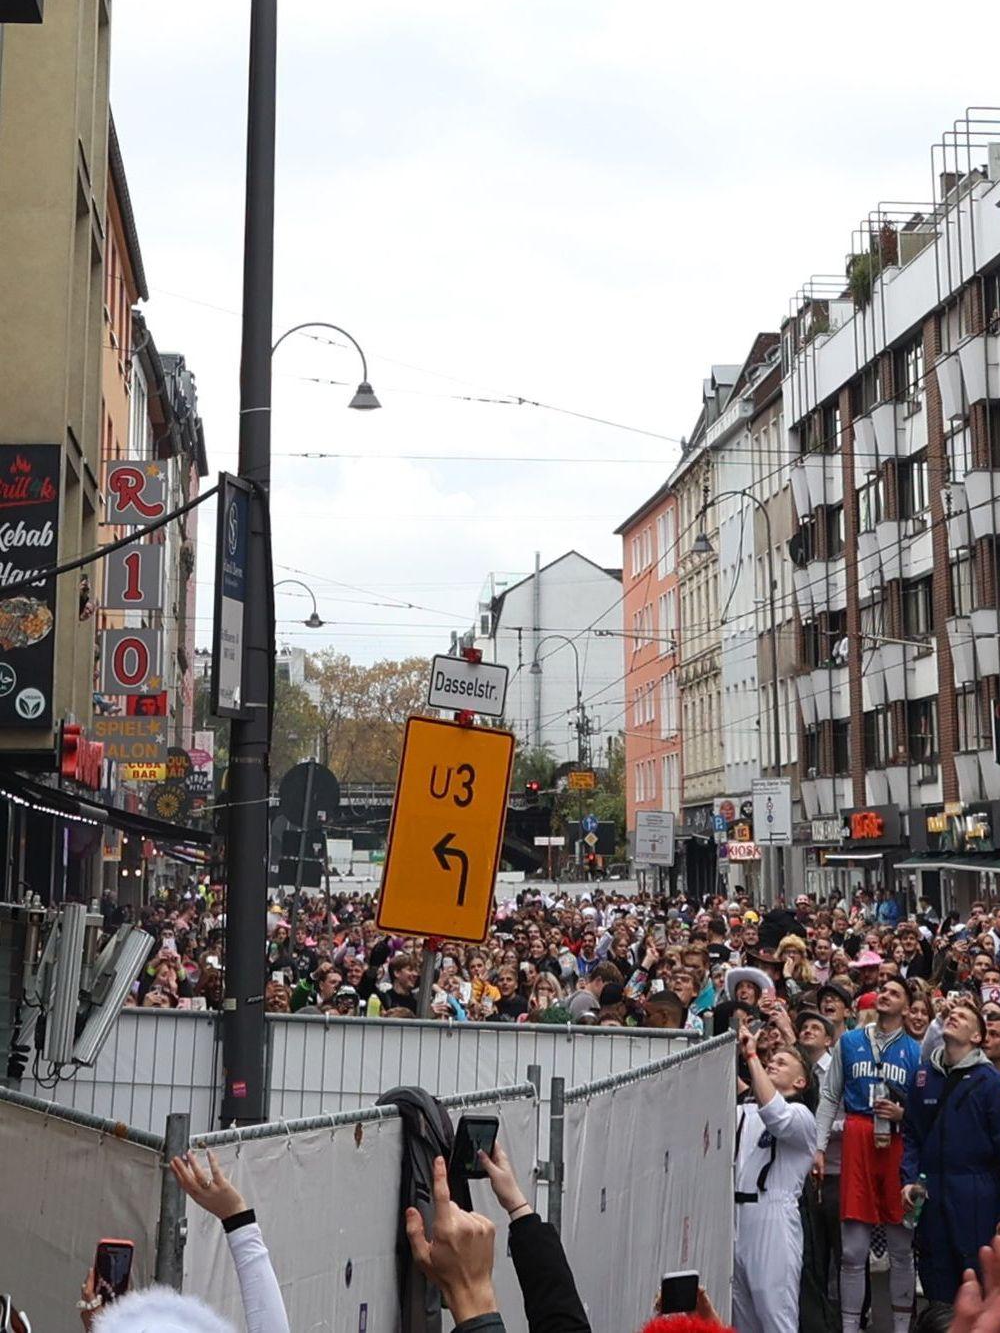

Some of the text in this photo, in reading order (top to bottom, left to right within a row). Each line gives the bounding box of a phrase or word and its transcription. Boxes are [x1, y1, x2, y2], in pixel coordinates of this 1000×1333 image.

[434, 671, 498, 701] Dasselstr.
[95, 721, 146, 737] SPIEL
[132, 769, 158, 779] BAR
[430, 764, 476, 807] U3
[728, 845, 762, 859] KIOSK
